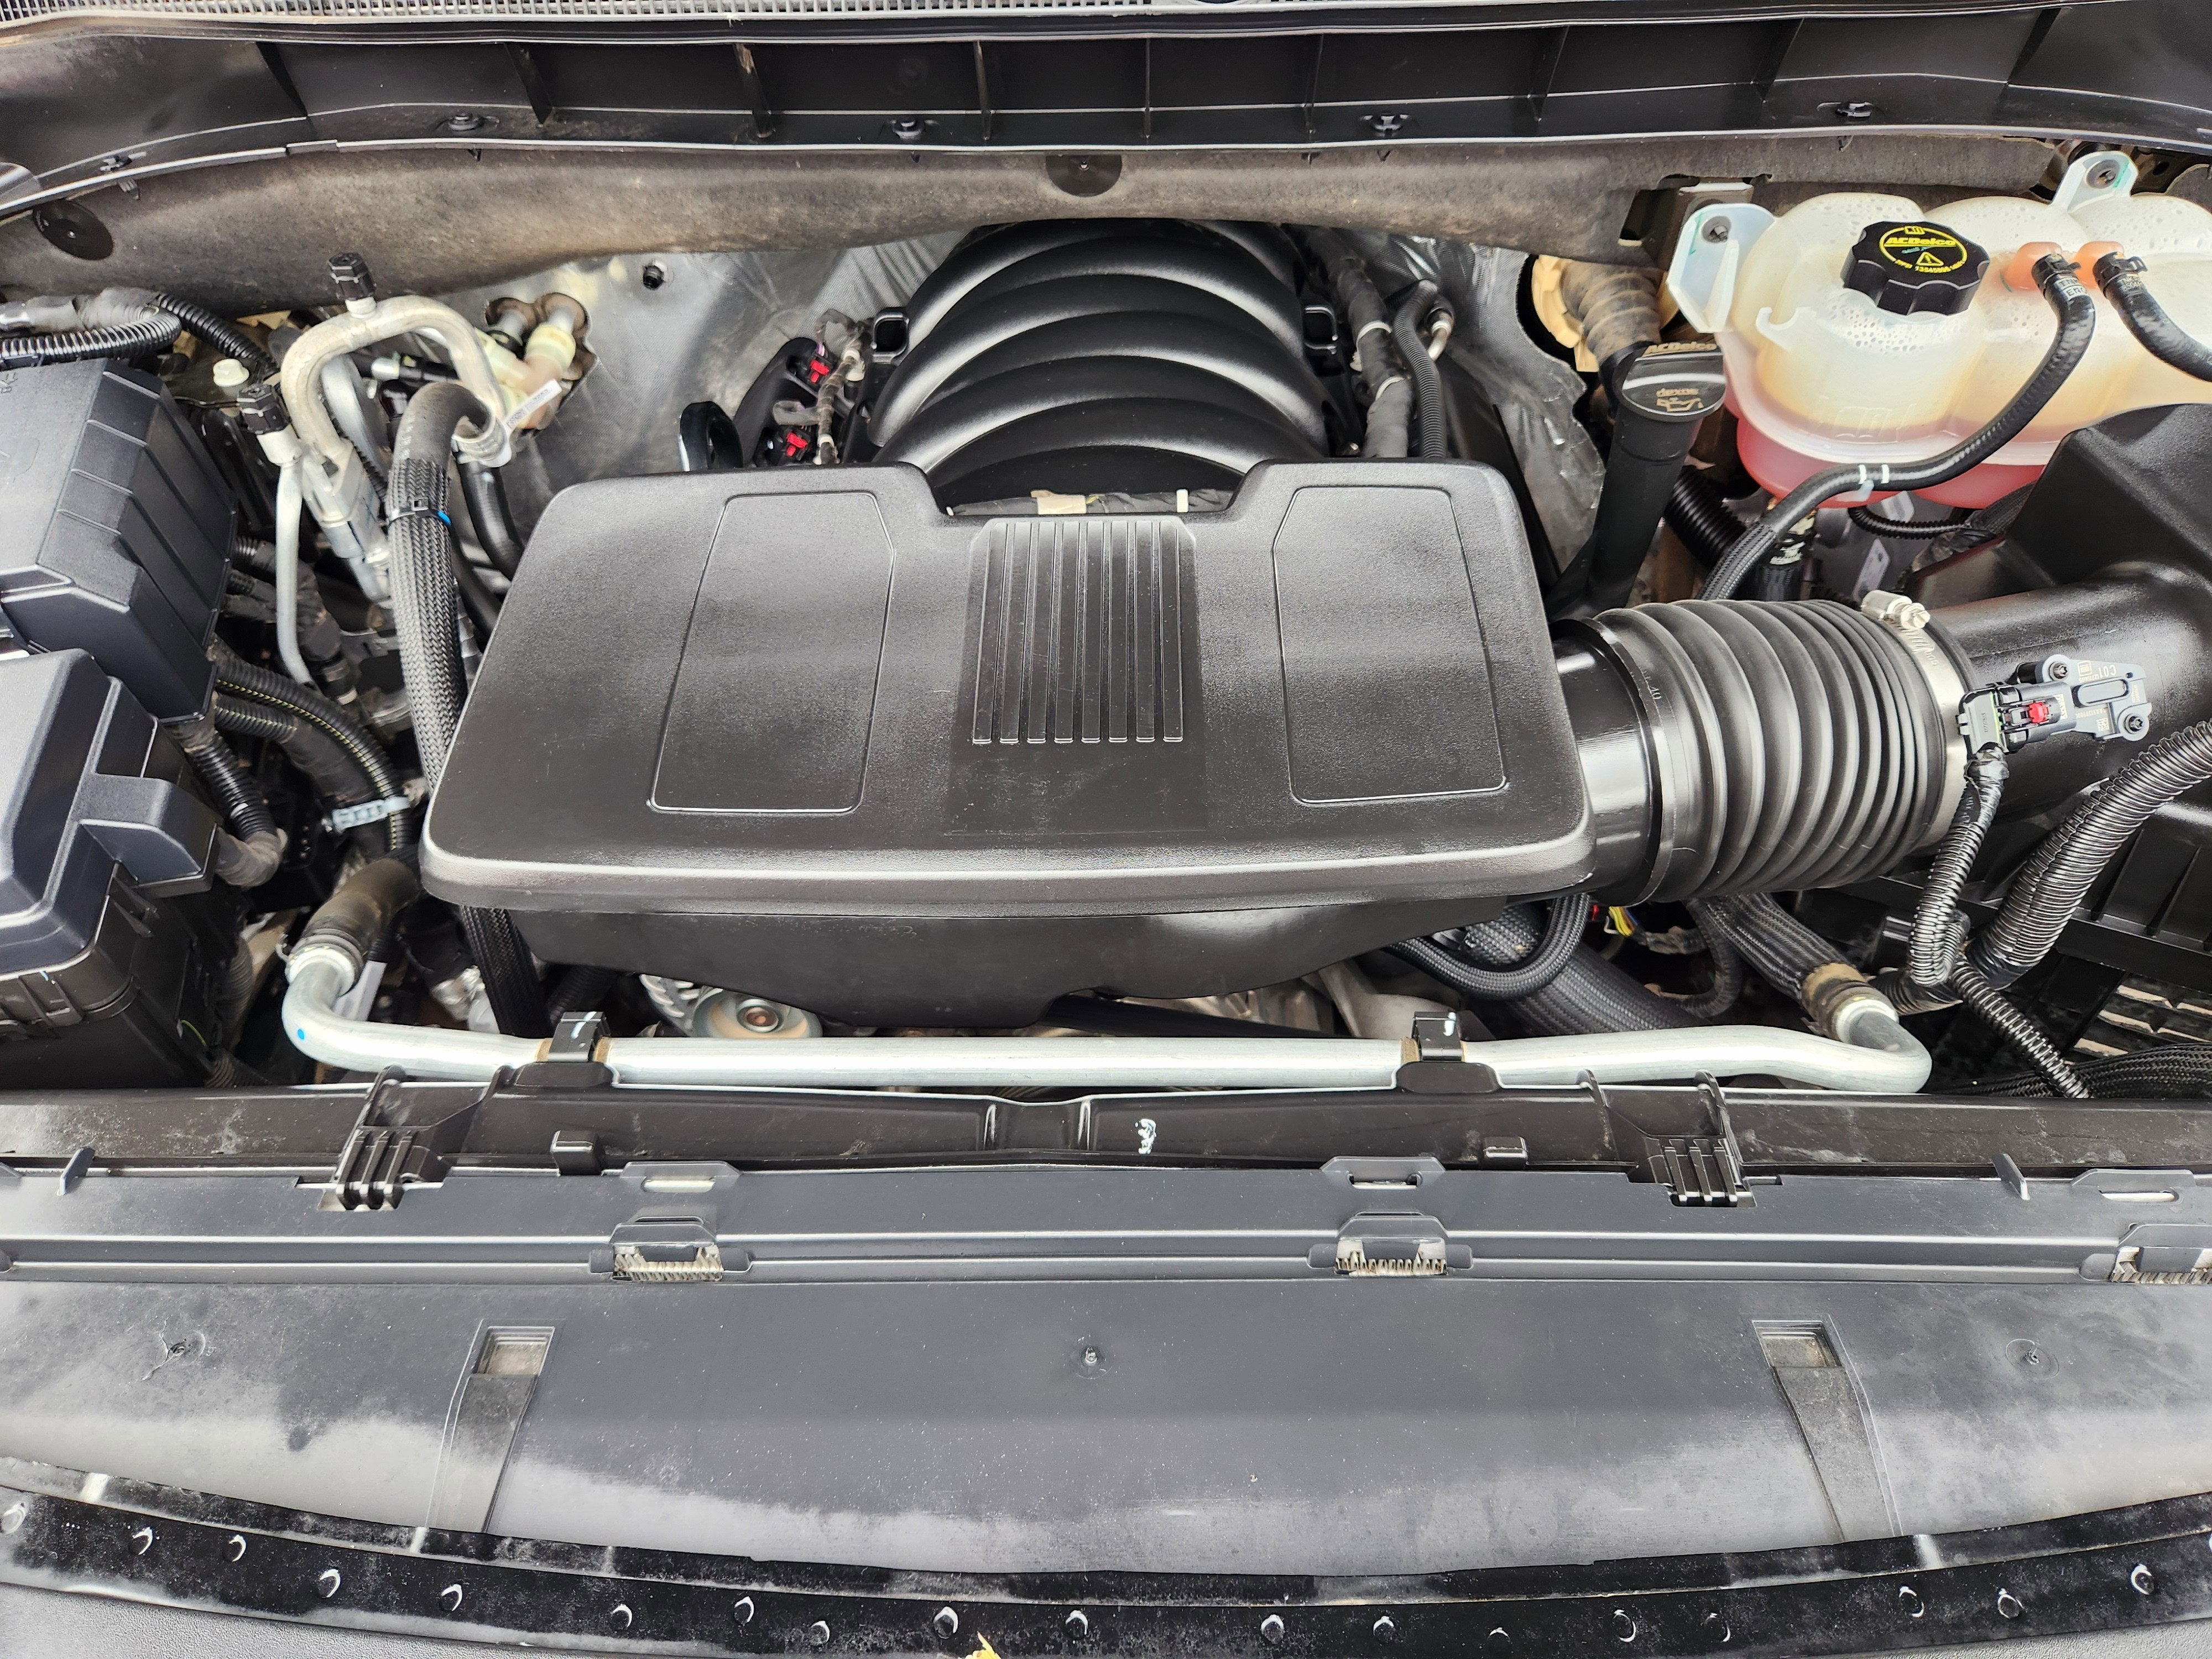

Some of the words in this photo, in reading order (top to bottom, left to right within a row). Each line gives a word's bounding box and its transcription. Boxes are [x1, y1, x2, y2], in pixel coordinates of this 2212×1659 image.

[1886, 237, 1956, 246] ACDelco
[1645, 341, 1717, 354] ACDelco
[1656, 388, 1699, 398] dexos
[2099, 665, 2116, 678] C01
